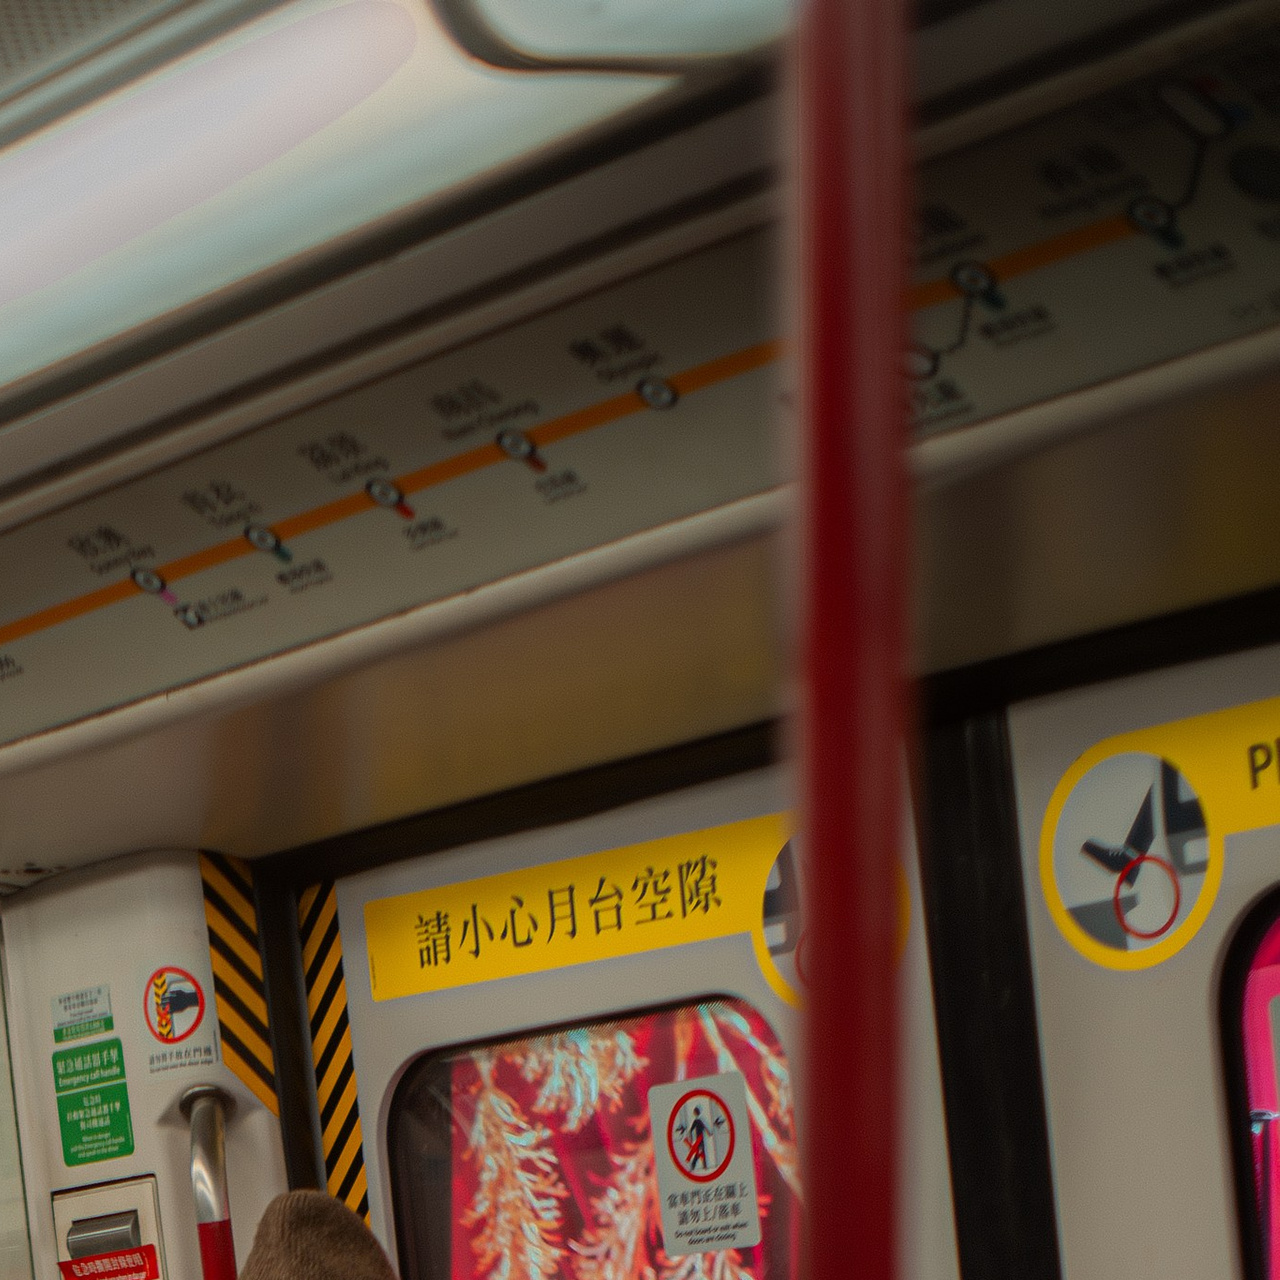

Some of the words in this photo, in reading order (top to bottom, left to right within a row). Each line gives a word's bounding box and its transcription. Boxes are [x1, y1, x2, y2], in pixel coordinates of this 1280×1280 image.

[414, 854, 723, 969] 請小心月台空隙
